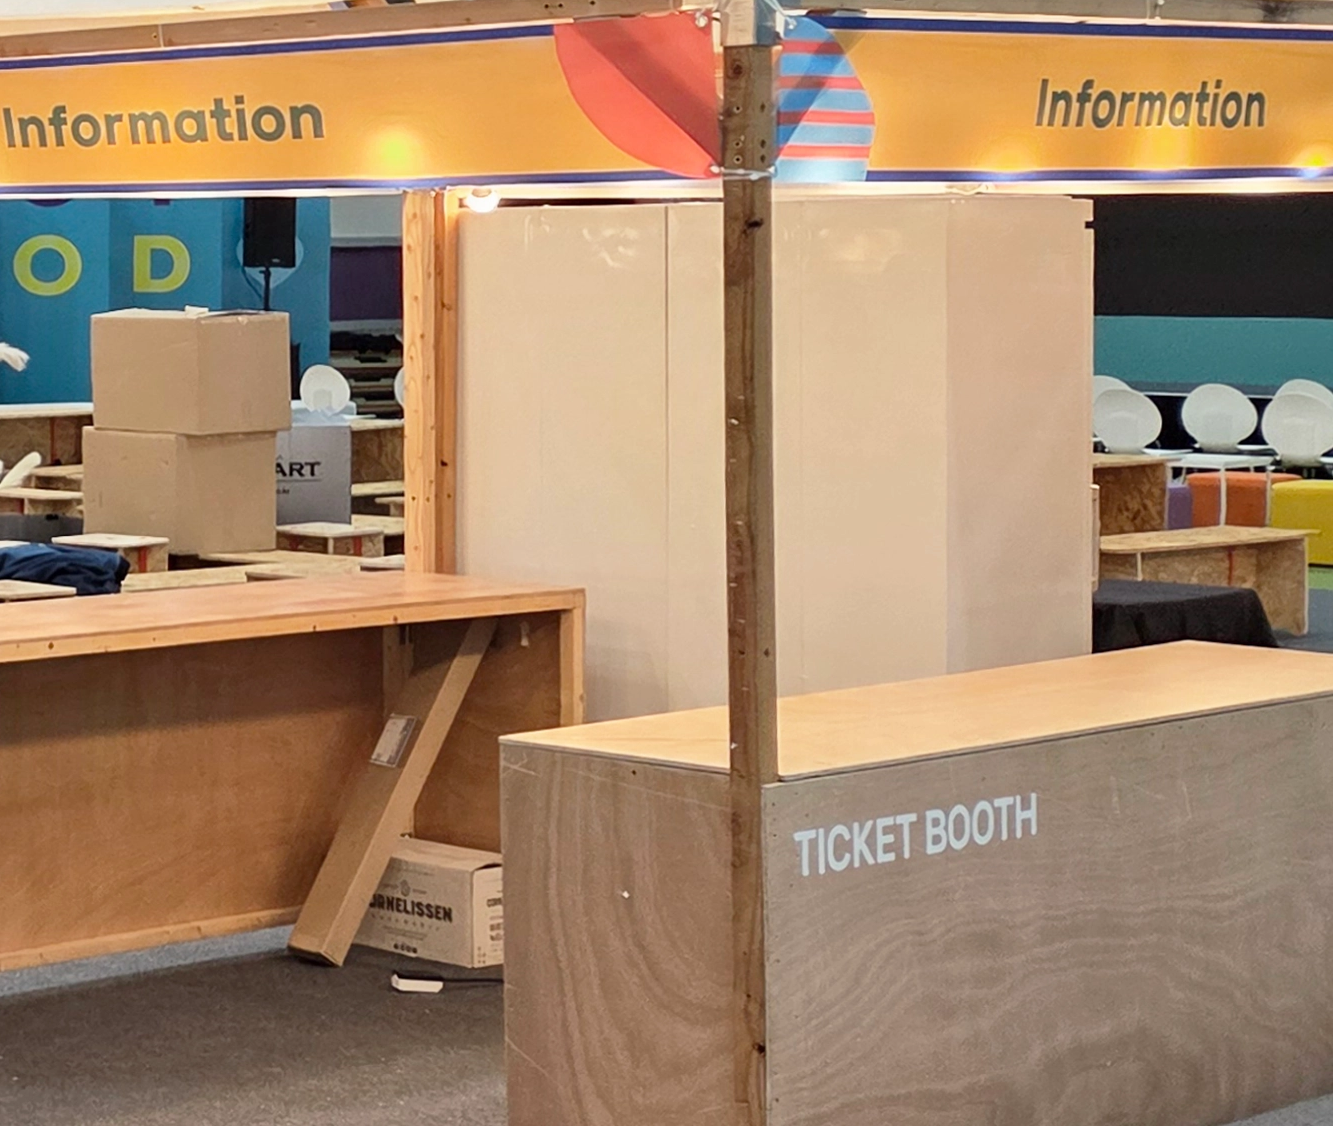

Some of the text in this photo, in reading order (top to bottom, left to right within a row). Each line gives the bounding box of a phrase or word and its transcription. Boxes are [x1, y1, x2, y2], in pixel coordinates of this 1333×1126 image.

[2, 94, 325, 149] Information
[1034, 77, 1267, 129] Information
[793, 792, 1038, 876] TICKET BOOTH
